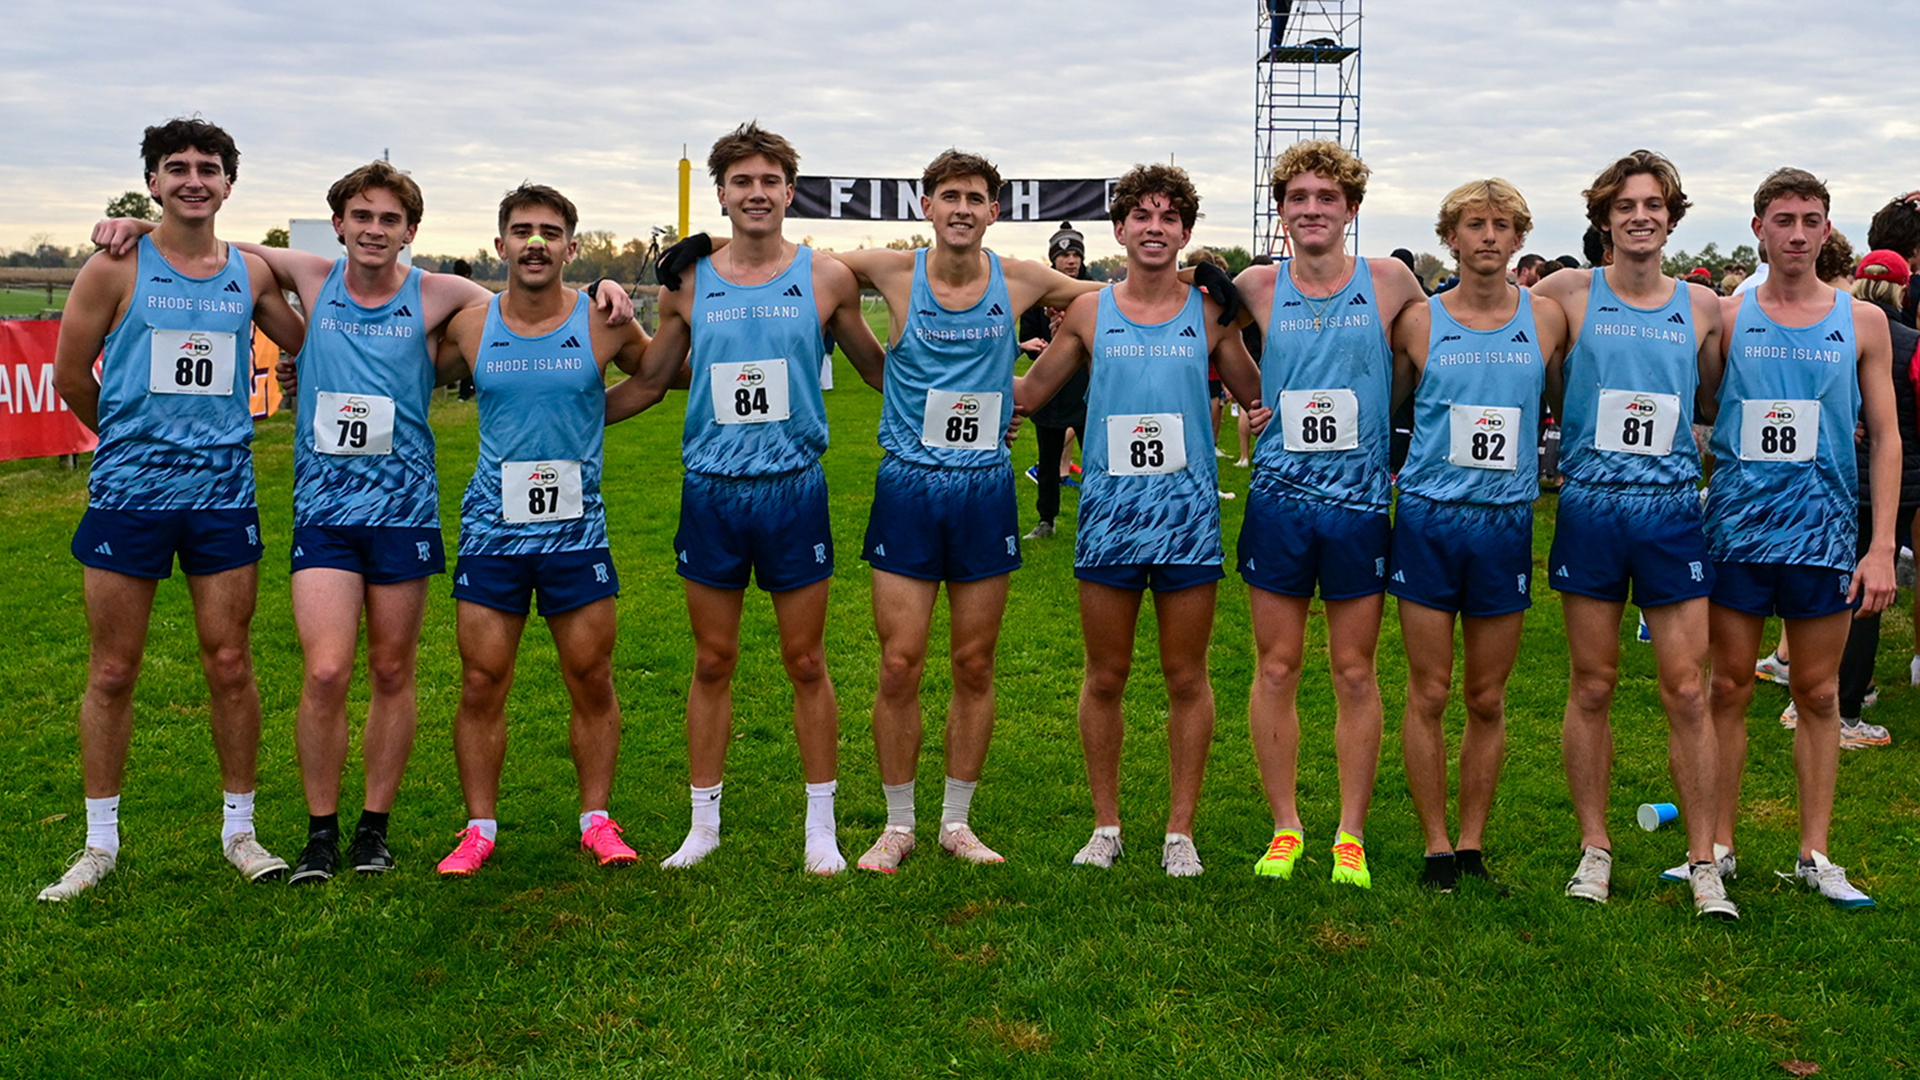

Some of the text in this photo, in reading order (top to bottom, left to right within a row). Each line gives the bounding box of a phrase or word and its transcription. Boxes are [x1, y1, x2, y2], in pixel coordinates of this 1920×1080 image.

[829, 178, 1040, 220] FINH
[147, 296, 244, 314] RHODE ISLAND
[706, 305, 799, 323] RHODE ISLAND
[320, 317, 413, 338] RHODE ISLAND
[916, 325, 1005, 341] RHODE ISLAND
[1325, 314, 1370, 329] ISLAND
[1594, 324, 1686, 344] RHODE ISLAND
[486, 357, 583, 373] RHODE ISLAND
[1105, 345, 1195, 358] RHODE ISLAND
[1439, 351, 1532, 366] RHODE ISLAND
[1744, 346, 1841, 363] RHODE ISLAND
[175, 357, 213, 387] 80
[734, 387, 769, 416] 84
[337, 420, 368, 448] 79
[945, 416, 979, 443] 85
[1302, 415, 1337, 444] 86
[1622, 417, 1654, 447] 81
[1761, 426, 1797, 454] 88
[1130, 440, 1164, 468] 83
[1471, 432, 1506, 462] 82
[528, 486, 559, 515] 87
